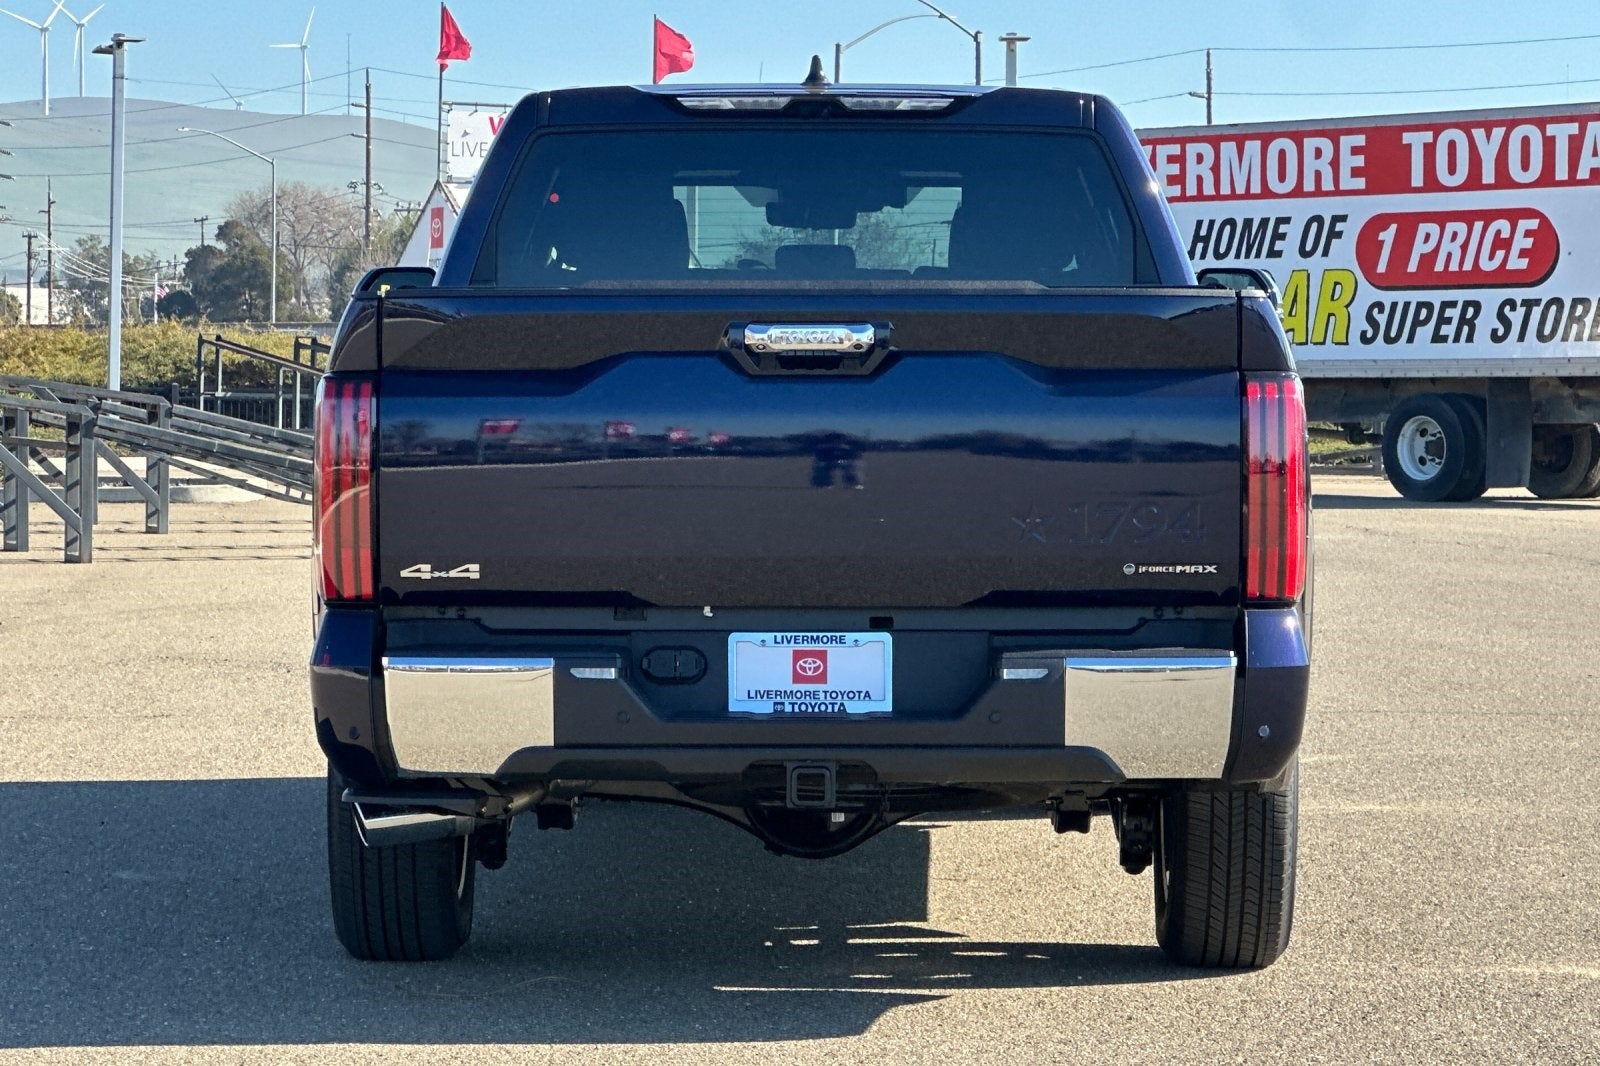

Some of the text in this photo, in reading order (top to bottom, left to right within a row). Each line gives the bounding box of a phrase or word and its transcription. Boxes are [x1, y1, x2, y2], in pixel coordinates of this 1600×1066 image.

[1402, 121, 1600, 188] TOYOTA
[1189, 214, 1349, 261] HOME OF
[1376, 218, 1541, 273] 1 PRICE
[1359, 299, 1483, 345] SUPER
[1068, 503, 1208, 544] 1794
[773, 635, 847, 645] LIVERMORE
[747, 690, 872, 700] LIVERMORE TOYOTA
[789, 702, 847, 713] TOYOTA
